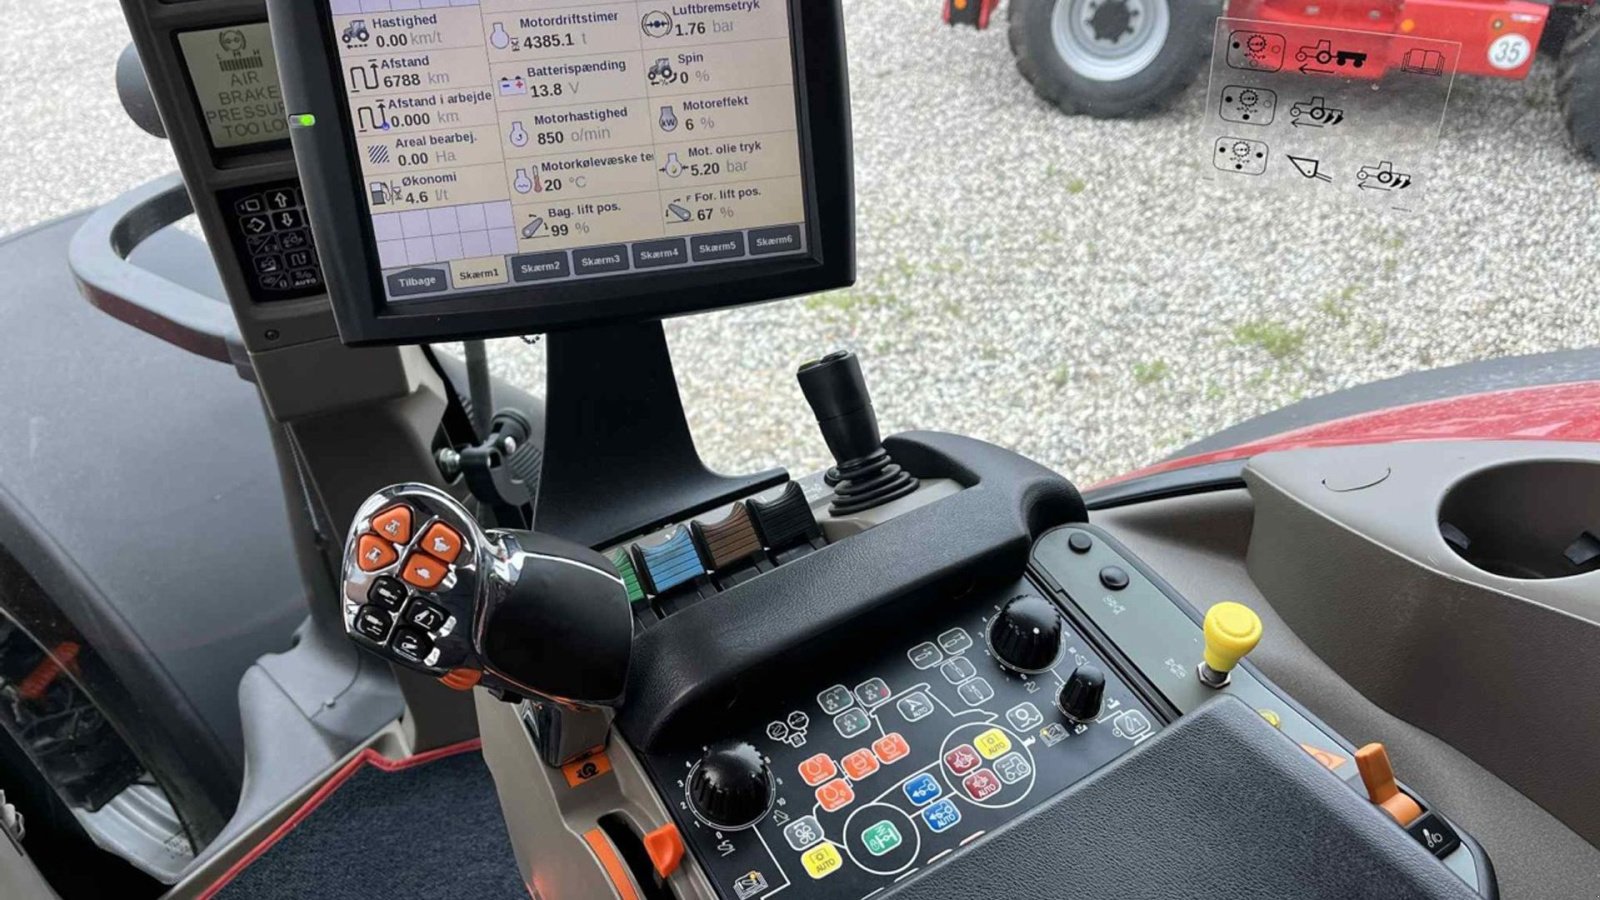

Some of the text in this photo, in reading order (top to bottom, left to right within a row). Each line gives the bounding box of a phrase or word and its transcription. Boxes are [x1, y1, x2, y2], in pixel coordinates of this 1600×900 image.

[672, 0, 760, 16] Luftbremsetryk
[372, 14, 437, 29] Hastighed
[520, 12, 619, 28] Motordriftstimer
[675, 20, 734, 36] 1.76 bar
[376, 30, 443, 48] 0.00 km/t
[524, 33, 587, 49] 4385.1 t
[678, 52, 704, 66] Spin
[1494, 40, 1524, 64] 35
[380, 55, 430, 70] Afstand
[527, 60, 626, 78] Batterispænding
[231, 71, 259, 86] AIR
[384, 71, 450, 88] 6788 km
[680, 70, 710, 84] 0 %
[218, 86, 280, 105] BRAKE
[530, 82, 580, 98] 13.8 V
[388, 90, 492, 110] Afstand i arbejde
[683, 96, 749, 111] Motoreffekt
[391, 110, 460, 128] 0.000 km
[534, 107, 628, 125] Motorhastighed
[686, 117, 714, 130] 6 %
[223, 122, 260, 138] TOO
[538, 127, 611, 145] 850 o/min
[396, 132, 477, 148] Areal bearbej.
[688, 141, 762, 158] Mot. olie tryk
[398, 150, 456, 166] 0.00 Ha
[541, 156, 638, 172] Motorkølevæske
[690, 160, 748, 176] 5.20 bar
[402, 172, 457, 187] Økonomi
[544, 176, 586, 192] 20 °C
[405, 191, 428, 204] 4.6
[694, 188, 762, 202] For. lift pos.
[548, 203, 621, 218] Bag. lift pos.
[697, 207, 734, 220] 67 %
[551, 222, 590, 237] 99 %
[699, 242, 737, 254] Skærm5
[756, 235, 793, 247] Skærm6
[581, 256, 621, 267] Skærm3
[640, 248, 680, 260] Skærm4
[460, 268, 499, 280] Skærm1
[521, 262, 560, 274] Skærm2
[398, 277, 437, 288] Tilbage
[913, 706, 928, 718] AUTO
[988, 742, 1006, 755] AUTO
[677, 780, 684, 788] 3
[978, 783, 996, 797] AUTO
[680, 802, 687, 810] 2
[694, 820, 700, 828] 1
[937, 814, 956, 828] AUTO
[716, 831, 723, 840] 0
[816, 858, 836, 872] AUTO
